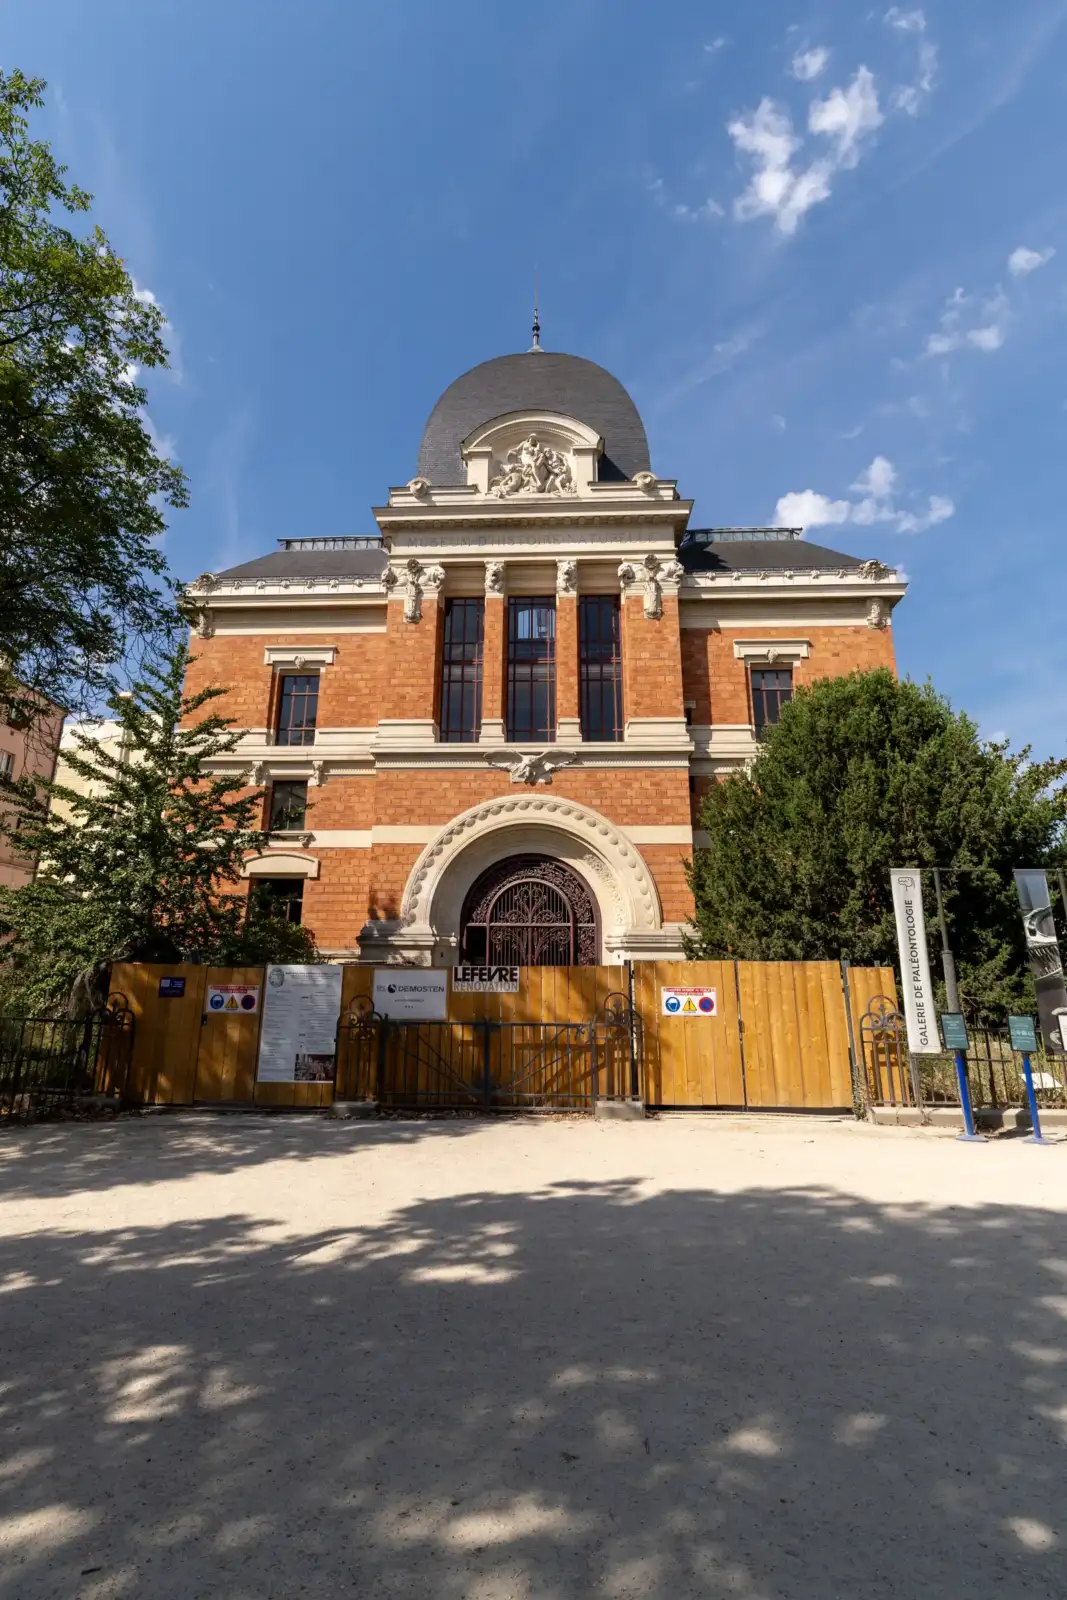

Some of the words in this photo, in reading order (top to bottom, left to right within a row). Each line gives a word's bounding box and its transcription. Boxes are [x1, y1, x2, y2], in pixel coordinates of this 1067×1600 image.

[904, 899, 921, 982] PALÉONTOLOGIE
[454, 966, 518, 982] LEFEVRE
[398, 984, 445, 993] DEMOSTEN
[454, 981, 518, 992] RENOVATION
[915, 985, 923, 998] DE
[917, 1001, 928, 1046] GALERIE
